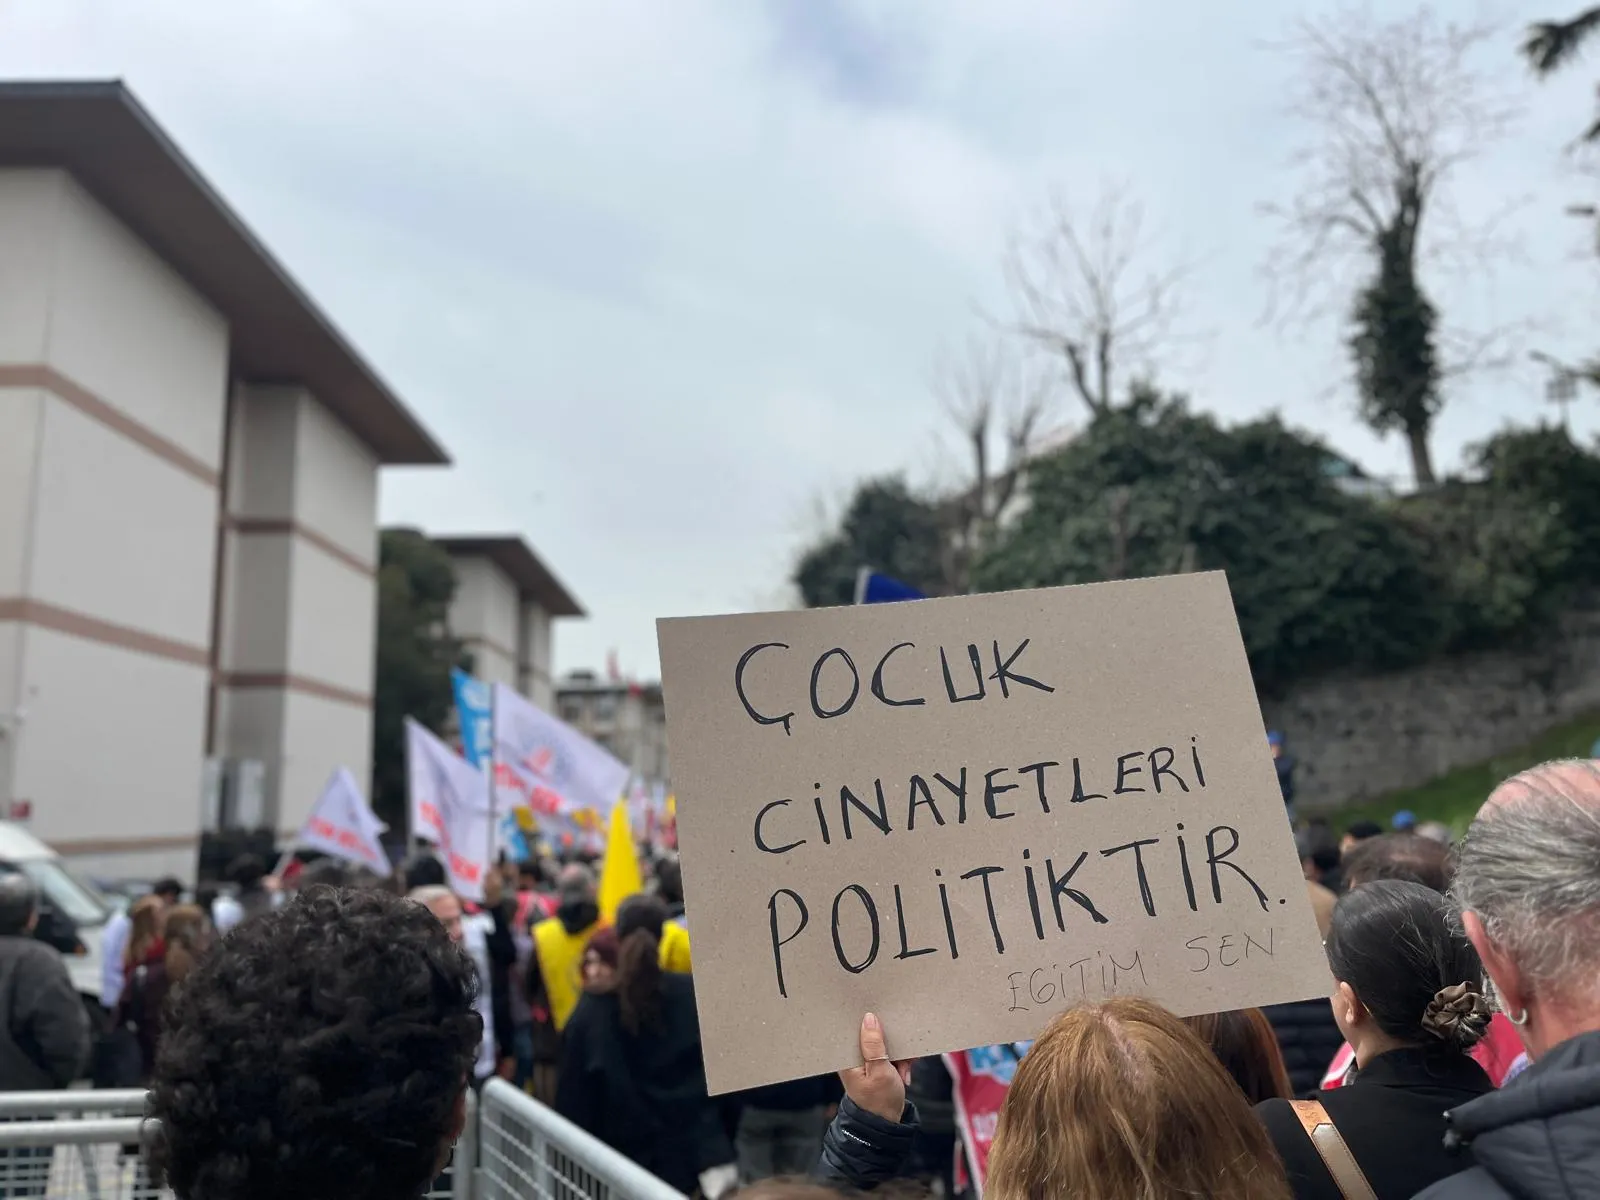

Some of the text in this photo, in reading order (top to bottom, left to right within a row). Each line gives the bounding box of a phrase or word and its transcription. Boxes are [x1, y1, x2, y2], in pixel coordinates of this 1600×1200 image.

[734, 638, 1056, 737] ÇOCUK
[753, 736, 1207, 854] CİNAYETLERİ
[767, 822, 1287, 999] POLİTİKTİR.
[1185, 927, 1274, 973] SEN
